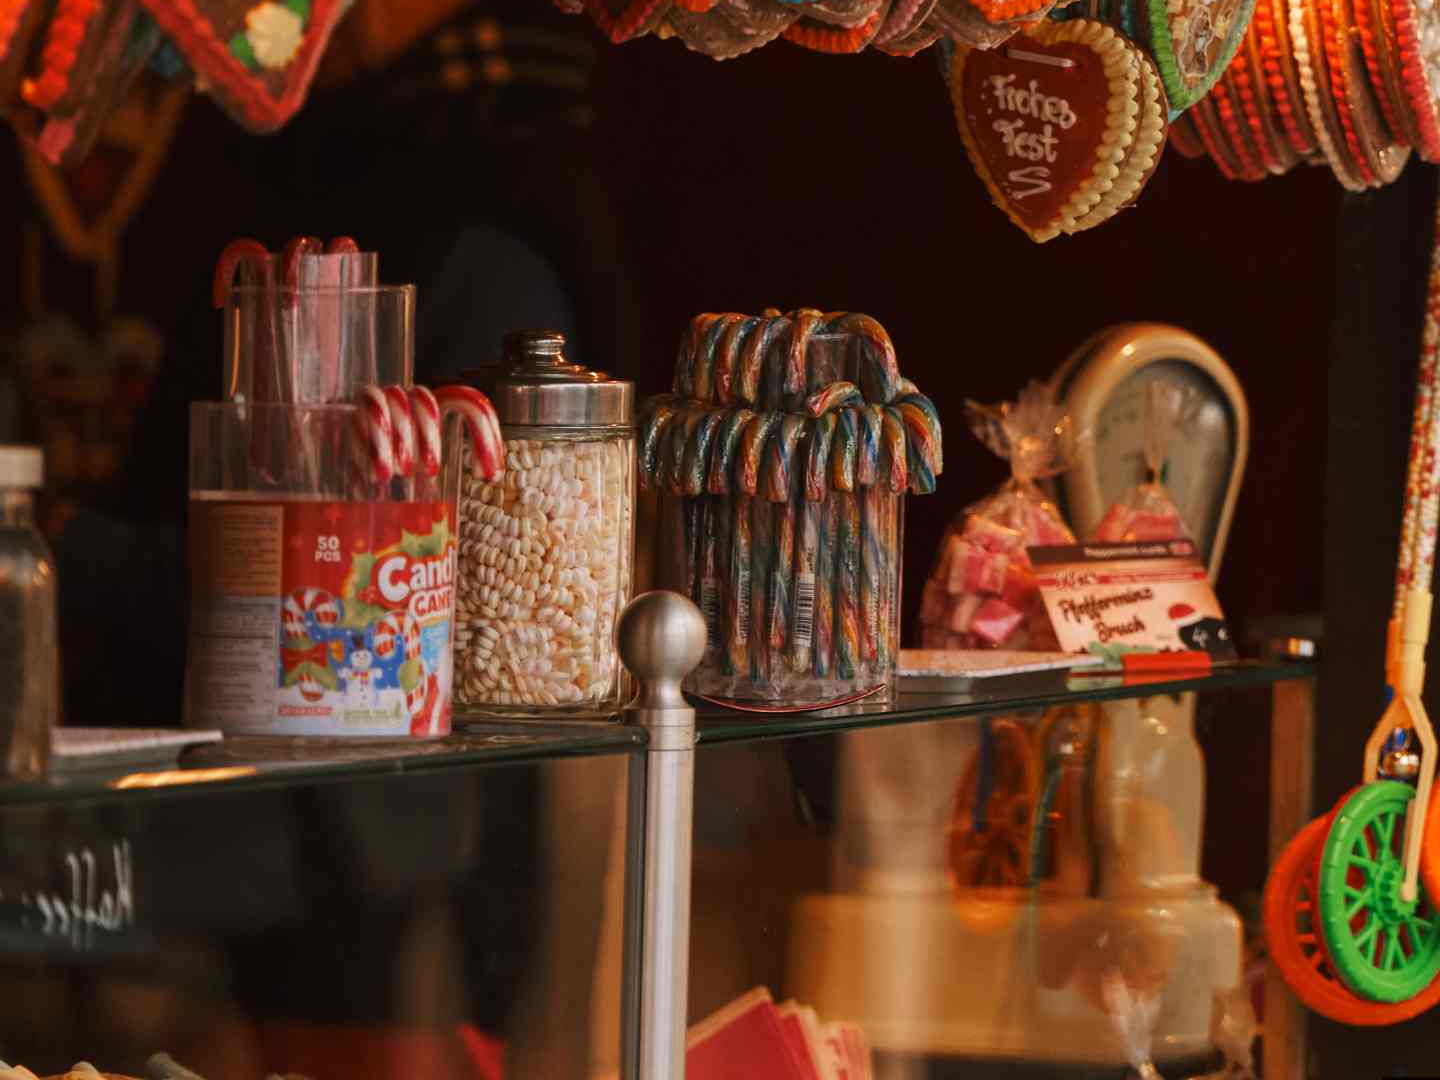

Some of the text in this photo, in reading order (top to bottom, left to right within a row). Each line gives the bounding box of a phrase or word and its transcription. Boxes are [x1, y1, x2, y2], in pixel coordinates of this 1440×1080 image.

[992, 118, 1060, 163] Fest
[314, 550, 342, 563] PCS
[317, 535, 341, 551] 50
[377, 545, 456, 603] Cand
